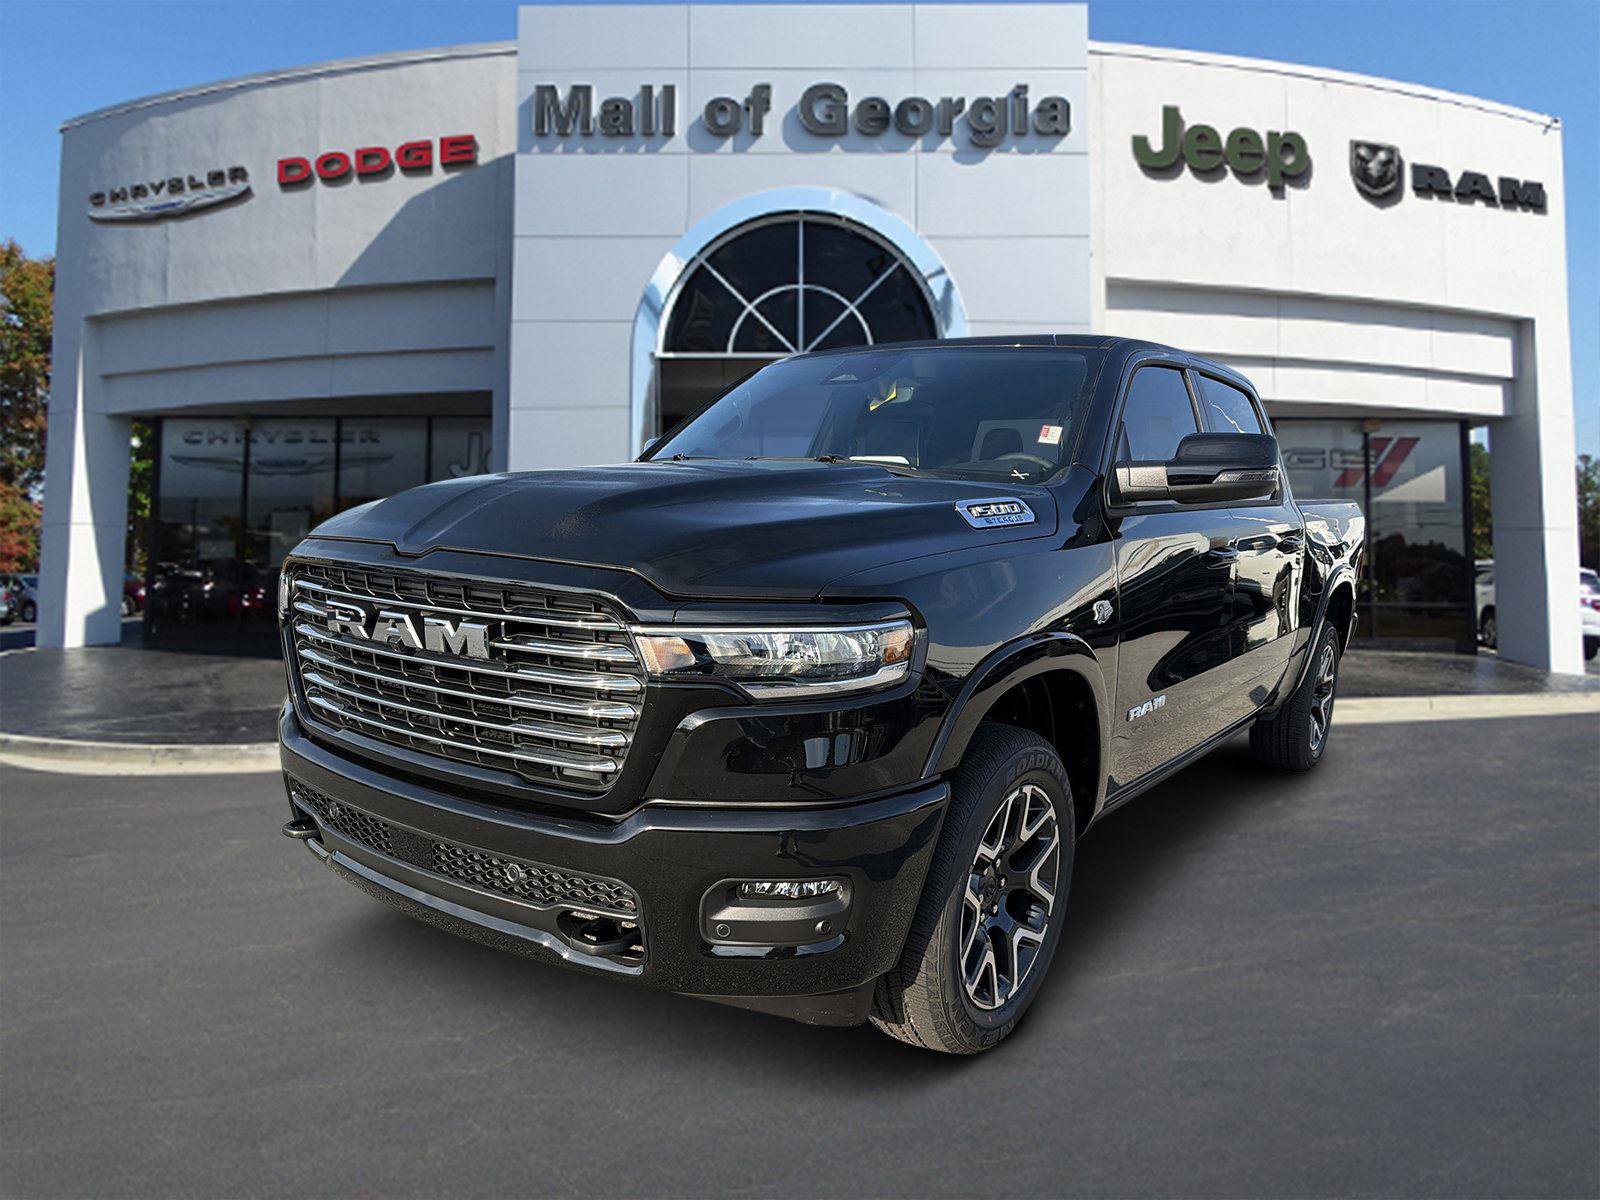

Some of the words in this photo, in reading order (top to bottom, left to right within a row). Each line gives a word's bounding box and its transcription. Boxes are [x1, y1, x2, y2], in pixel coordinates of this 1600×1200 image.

[533, 84, 675, 137] Mall
[704, 83, 771, 137] of
[800, 82, 1071, 148] Georgia
[277, 134, 478, 189] DODGE
[1131, 105, 1311, 197] Jeep
[90, 166, 249, 207] CHRYSLER
[1411, 163, 1547, 214] RAM
[969, 503, 1021, 518] 1500
[326, 599, 490, 659] RAM
[1127, 694, 1166, 722] RAM
